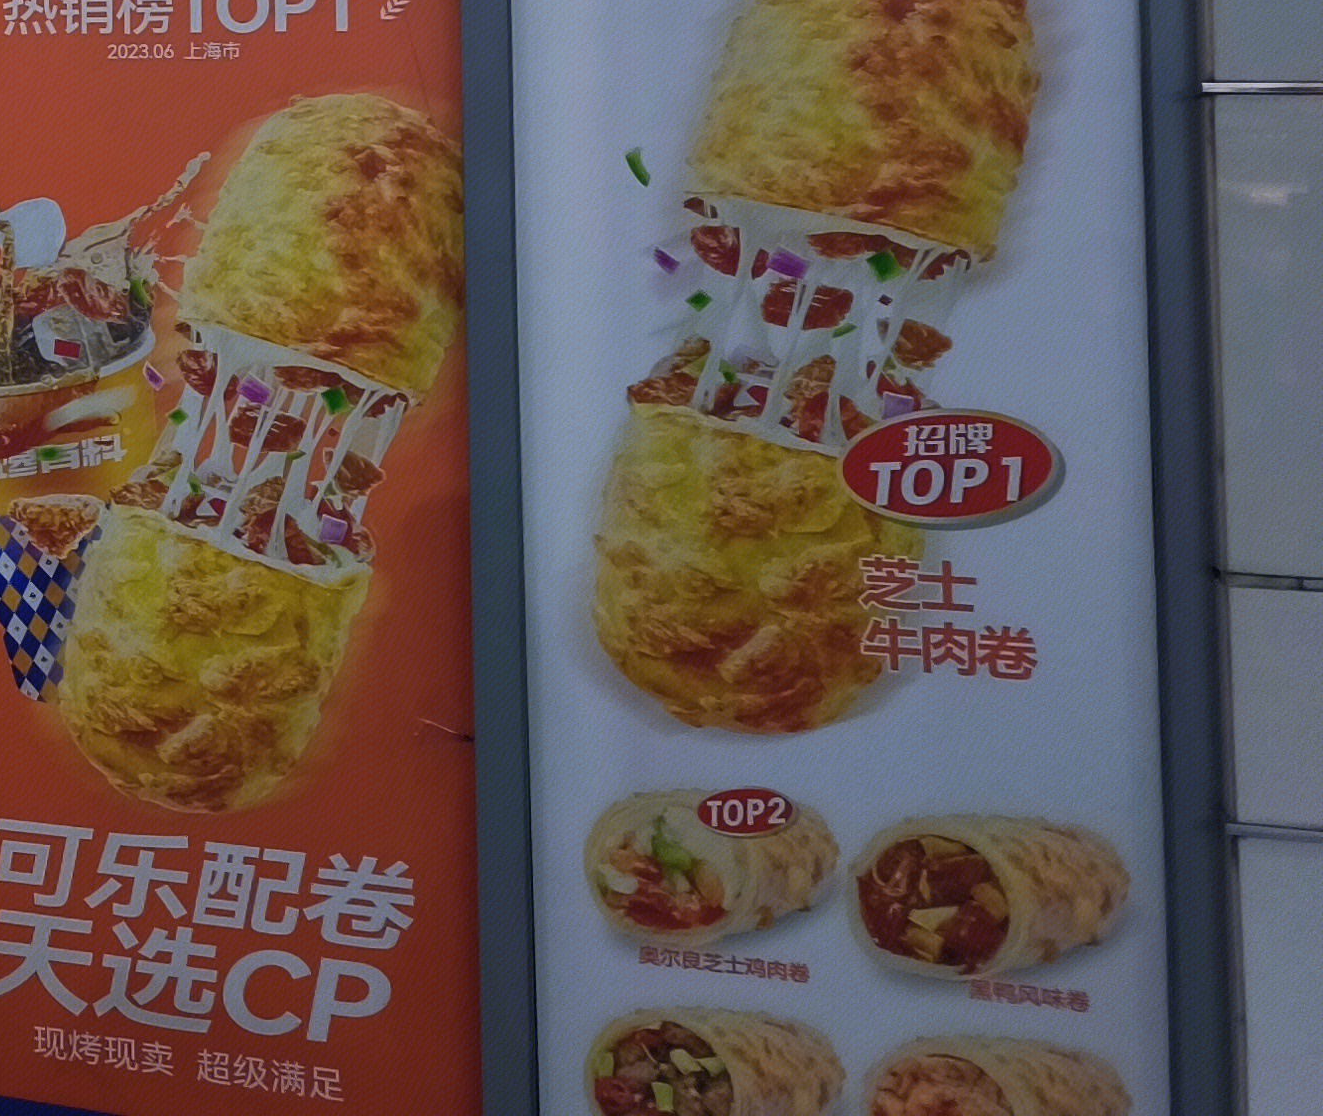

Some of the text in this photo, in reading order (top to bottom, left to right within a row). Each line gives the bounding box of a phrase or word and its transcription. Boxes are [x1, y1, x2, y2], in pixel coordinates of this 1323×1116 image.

[108, 42, 240, 60] 2023.06 上海市
[904, 423, 993, 456] 招牌
[858, 554, 977, 613] 芝士
[859, 618, 1038, 680] 牛肉卷
[705, 796, 787, 828] TOP2
[639, 945, 810, 984] 奥尔良芝士鸡肉卷
[33, 1025, 346, 1102] 现烤现卖 超级满足
